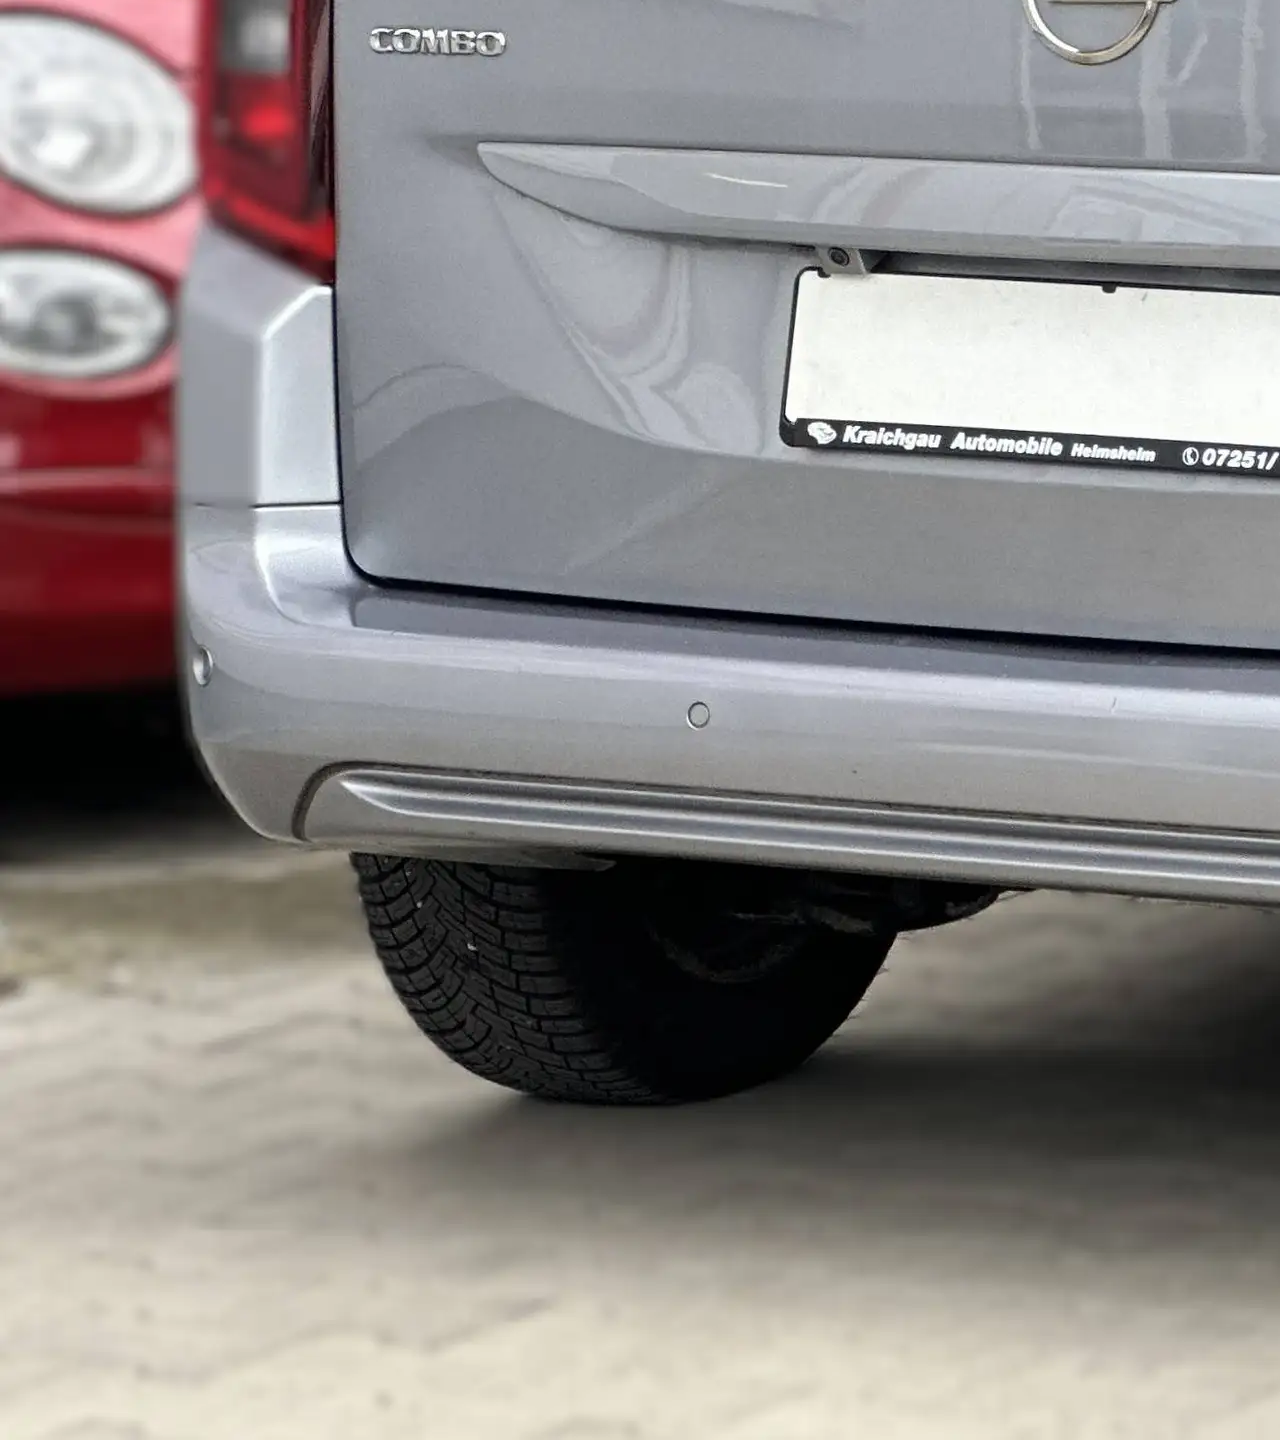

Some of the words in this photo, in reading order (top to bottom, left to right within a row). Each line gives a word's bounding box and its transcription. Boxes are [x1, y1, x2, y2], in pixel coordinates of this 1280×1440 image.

[368, 26, 507, 57] COMBO
[842, 425, 942, 451] Kraichgau
[950, 431, 1063, 456] Automobile
[1202, 448, 1279, 471] 07251/
